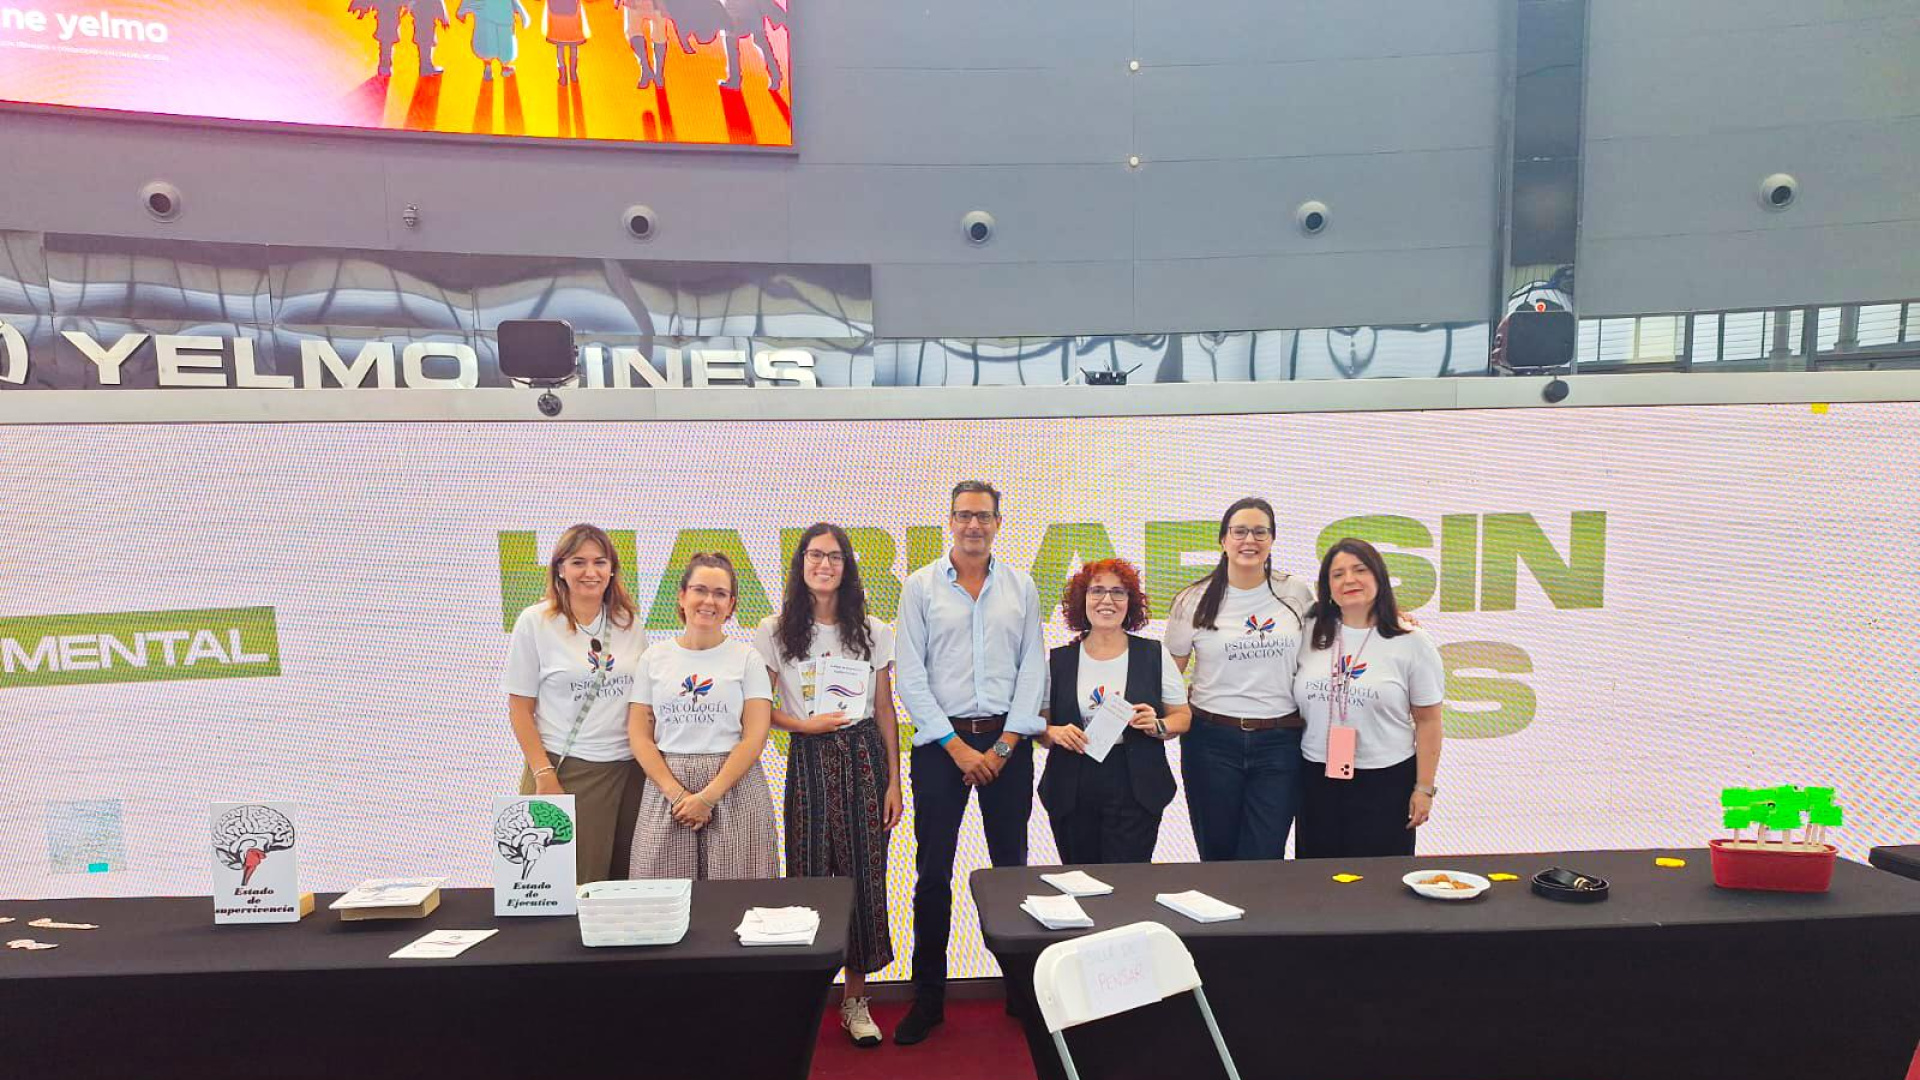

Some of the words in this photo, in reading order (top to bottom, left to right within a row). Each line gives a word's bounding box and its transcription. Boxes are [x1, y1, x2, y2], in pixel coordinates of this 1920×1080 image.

[56, 11, 169, 43] yelmo
[60, 331, 479, 389] YELMO
[511, 345, 817, 388] INES
[498, 523, 1222, 634] HABA
[1316, 511, 1607, 613] SIN
[0, 629, 270, 673] MENTAL
[570, 674, 634, 691] PSICLOGÍA
[234, 887, 274, 896] Estado
[513, 882, 551, 890] Estado
[247, 897, 261, 905] de
